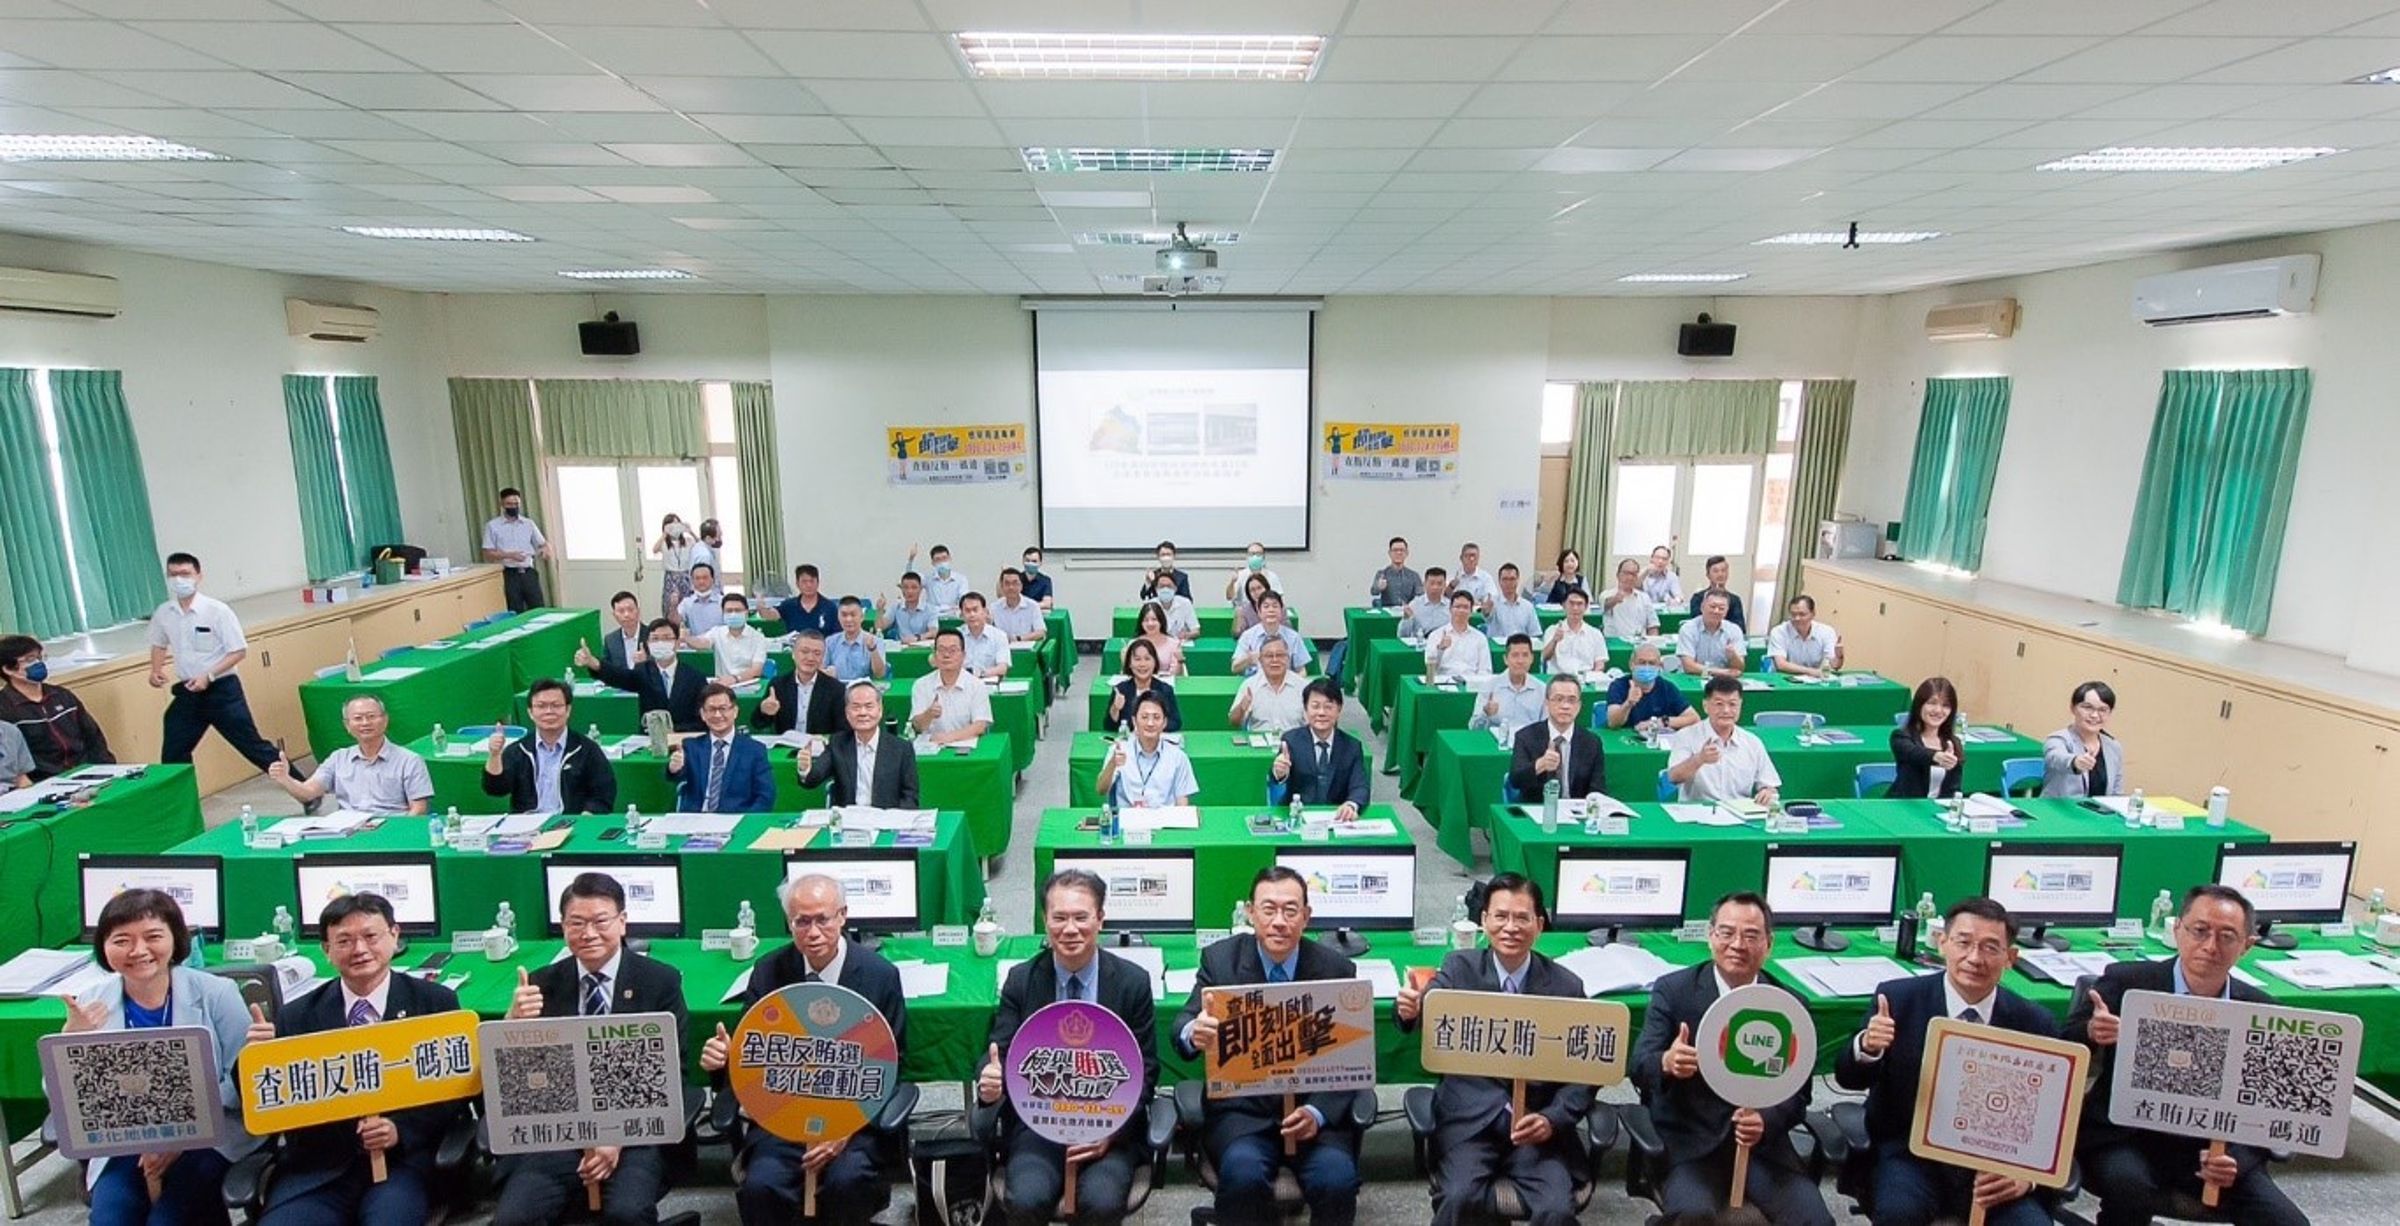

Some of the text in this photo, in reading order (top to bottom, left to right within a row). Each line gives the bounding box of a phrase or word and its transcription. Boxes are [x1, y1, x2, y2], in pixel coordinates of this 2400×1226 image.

[1226, 989, 1264, 1018] 查賄
[2152, 1002, 2218, 1022] WEB@
[503, 1029, 560, 1045] WEB@
[587, 1022, 662, 1040] LINE@
[1433, 1013, 1617, 1064] 查賄反賄一碼通
[1743, 1032, 1775, 1048] LINE
[2251, 1013, 2344, 1037] LINE@
[741, 1031, 863, 1068] 全民反賄選
[1019, 1048, 1131, 1079] 檢舉賄選
[254, 1036, 474, 1110] 查賄反賄一碼通
[764, 1066, 885, 1100] 彰化總動員
[507, 1116, 666, 1146] 查賄反賄一碼通
[2131, 1099, 2321, 1147] 查賄反賄一碼通
